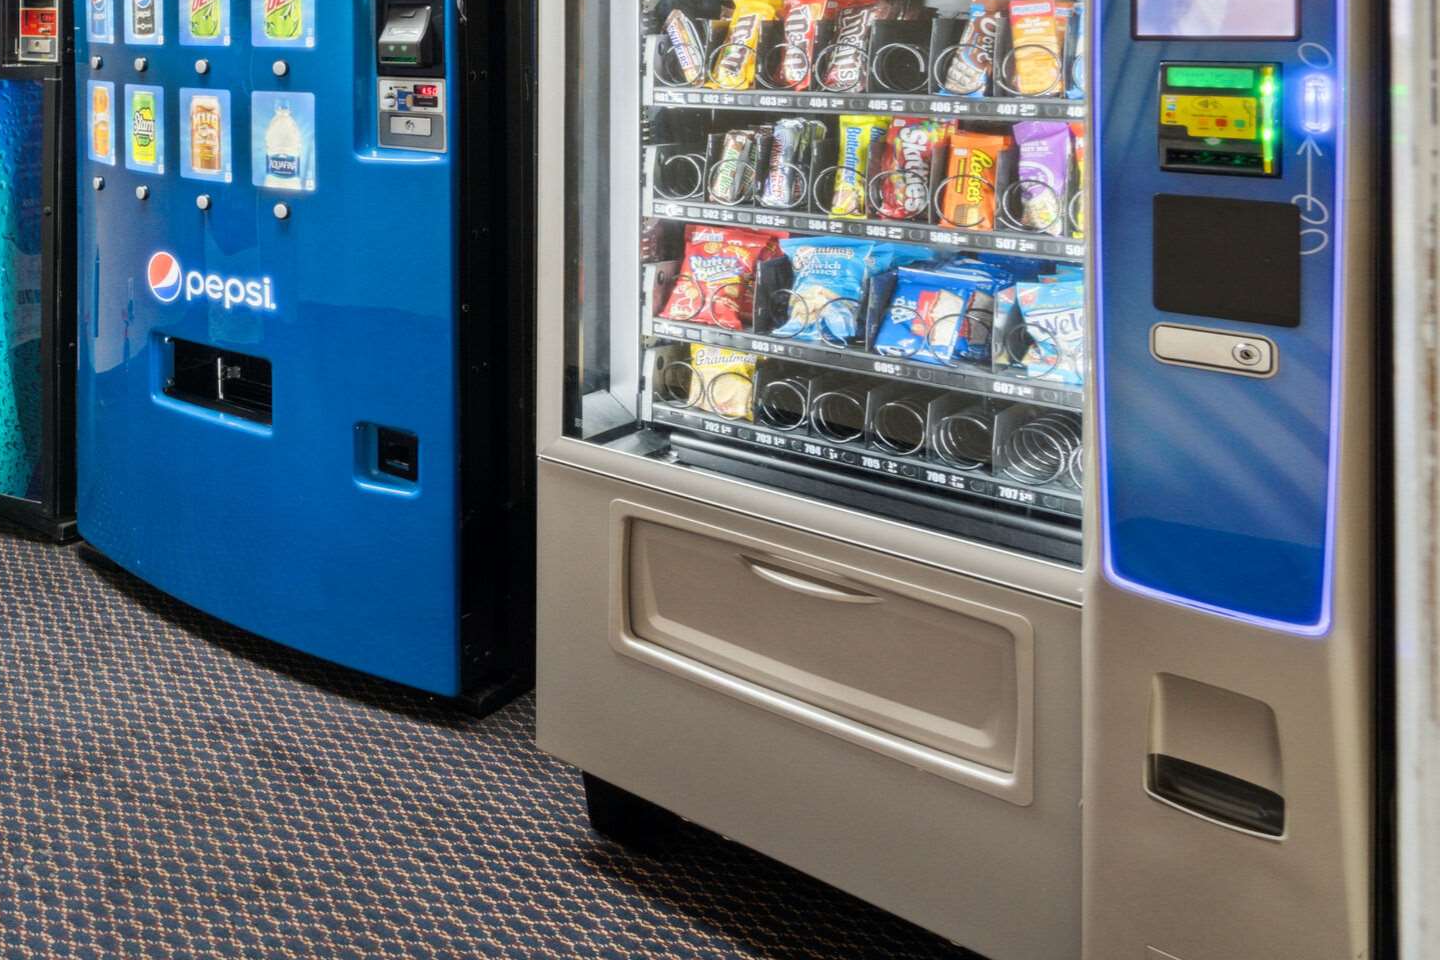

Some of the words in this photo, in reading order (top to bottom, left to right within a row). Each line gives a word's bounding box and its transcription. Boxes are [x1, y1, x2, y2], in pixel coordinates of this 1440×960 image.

[703, 95, 719, 104] 402
[760, 96, 777, 107] 403
[809, 98, 828, 108] 404
[868, 100, 888, 111] 405
[930, 102, 951, 113] 406
[996, 104, 1017, 115] 407
[843, 126, 862, 187] Butterfinger
[899, 127, 928, 213] Skittles
[703, 208, 719, 220] 502
[755, 215, 773, 226] 503
[809, 220, 827, 231] 504
[866, 225, 887, 237] 505
[930, 231, 951, 242] 506
[995, 238, 1016, 250] 507
[874, 362, 894, 375] 605
[993, 381, 1014, 395] 607
[704, 422, 720, 432] 702
[755, 433, 772, 445] 703
[804, 445, 822, 457] 704
[861, 456, 881, 469] 705
[926, 470, 947, 484] 706
[998, 486, 1018, 501] 707
